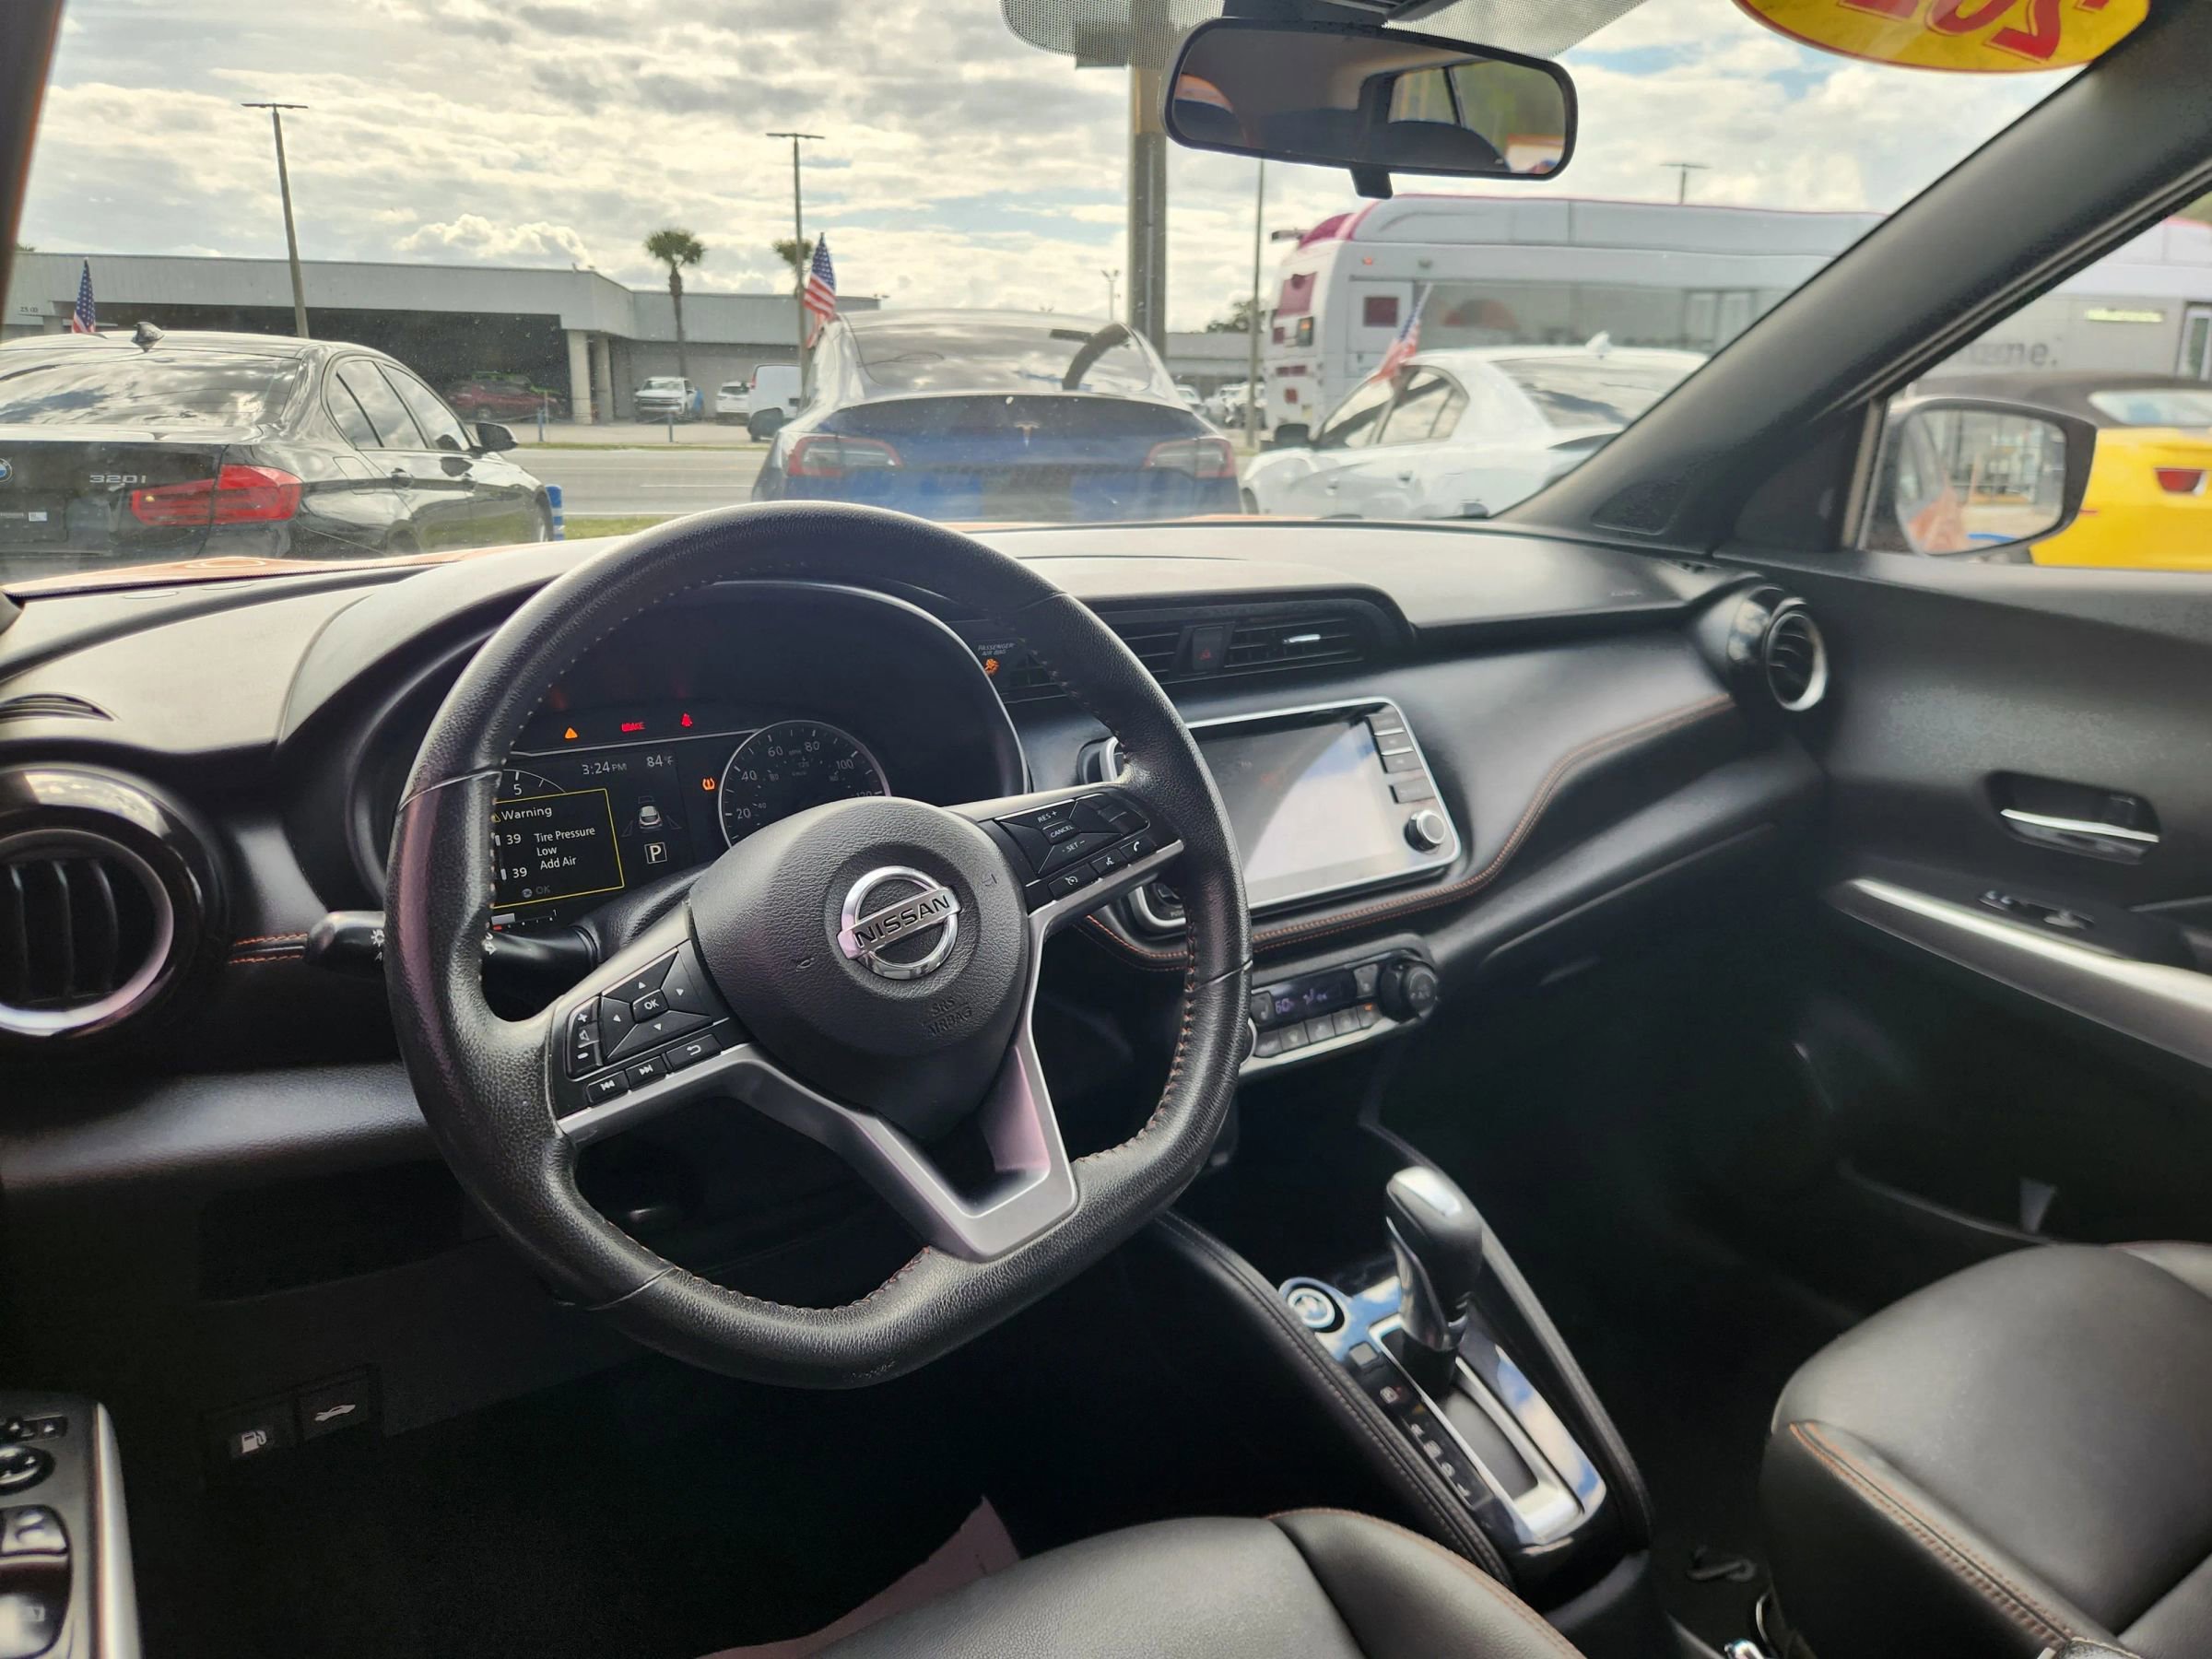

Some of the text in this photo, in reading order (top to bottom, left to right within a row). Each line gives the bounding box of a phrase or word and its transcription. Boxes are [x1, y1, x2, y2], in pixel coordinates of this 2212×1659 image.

[768, 746, 783, 758] 60
[804, 741, 820, 752] 80
[582, 761, 610, 775] 3:24
[836, 759, 854, 771] 100
[741, 770, 758, 782] 40
[513, 783, 523, 795] 5
[500, 806, 553, 821] Warning
[736, 807, 752, 819] 20
[534, 827, 596, 843] Tire Pressure
[1050, 825, 1076, 839] CANCEL
[506, 833, 522, 845] 39
[536, 846, 558, 857] Low
[1066, 842, 1079, 853] SET
[540, 855, 577, 871] Add Air
[512, 866, 528, 878] 39
[535, 885, 551, 895] OK
[853, 894, 951, 948] NISSAN
[643, 999, 660, 1010] OK
